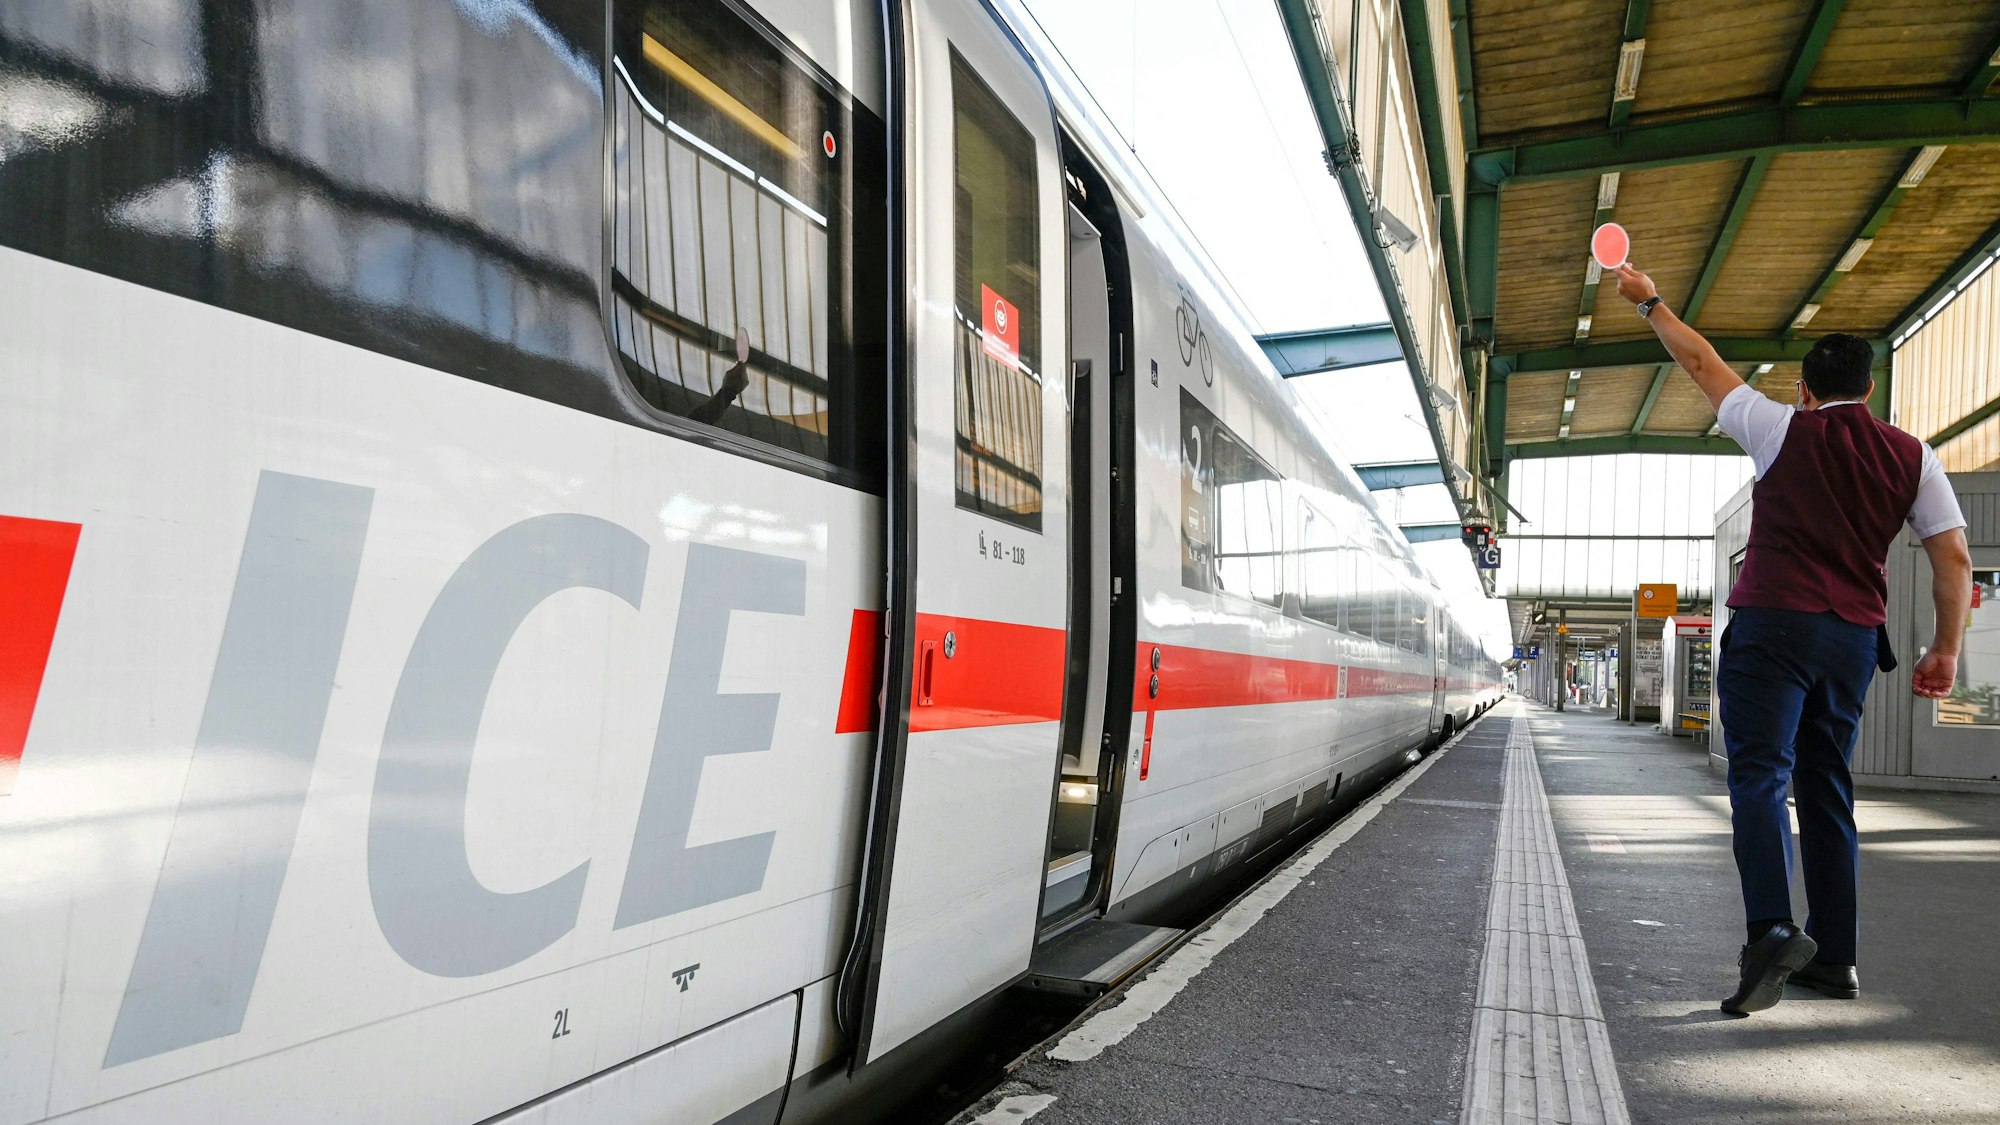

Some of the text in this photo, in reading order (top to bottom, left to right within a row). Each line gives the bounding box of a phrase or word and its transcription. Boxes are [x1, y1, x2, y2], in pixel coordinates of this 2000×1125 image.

[1191, 425, 1203, 494] 2
[993, 540, 1002, 559] 81
[1012, 545, 1025, 565] 118
[1484, 548, 1499, 565] G
[103, 469, 806, 1069] ICE
[552, 1008, 571, 1039] 2L
